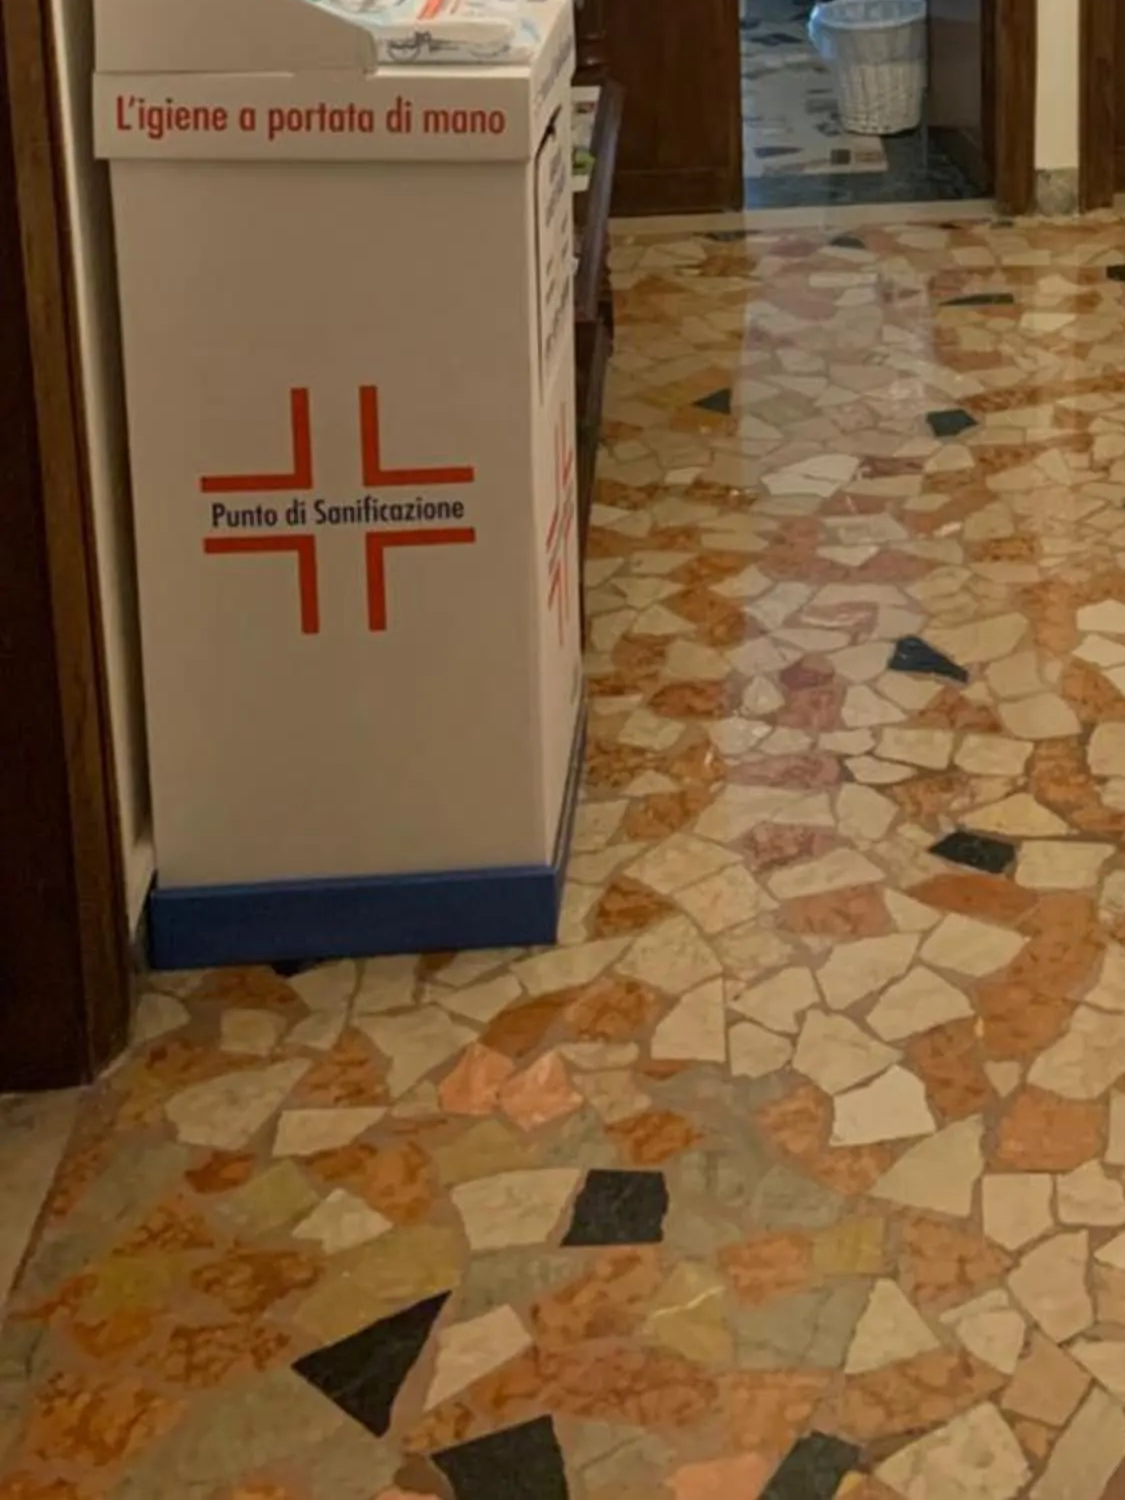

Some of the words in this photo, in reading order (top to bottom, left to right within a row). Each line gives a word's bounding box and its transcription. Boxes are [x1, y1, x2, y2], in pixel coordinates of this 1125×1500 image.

[116, 94, 228, 140] L'igiene
[238, 106, 256, 132] a
[268, 102, 375, 141] portata
[386, 96, 412, 133] di
[423, 108, 507, 135] mano
[211, 502, 278, 528] Punto
[286, 498, 307, 527] di
[314, 494, 465, 525] Sanificazione
